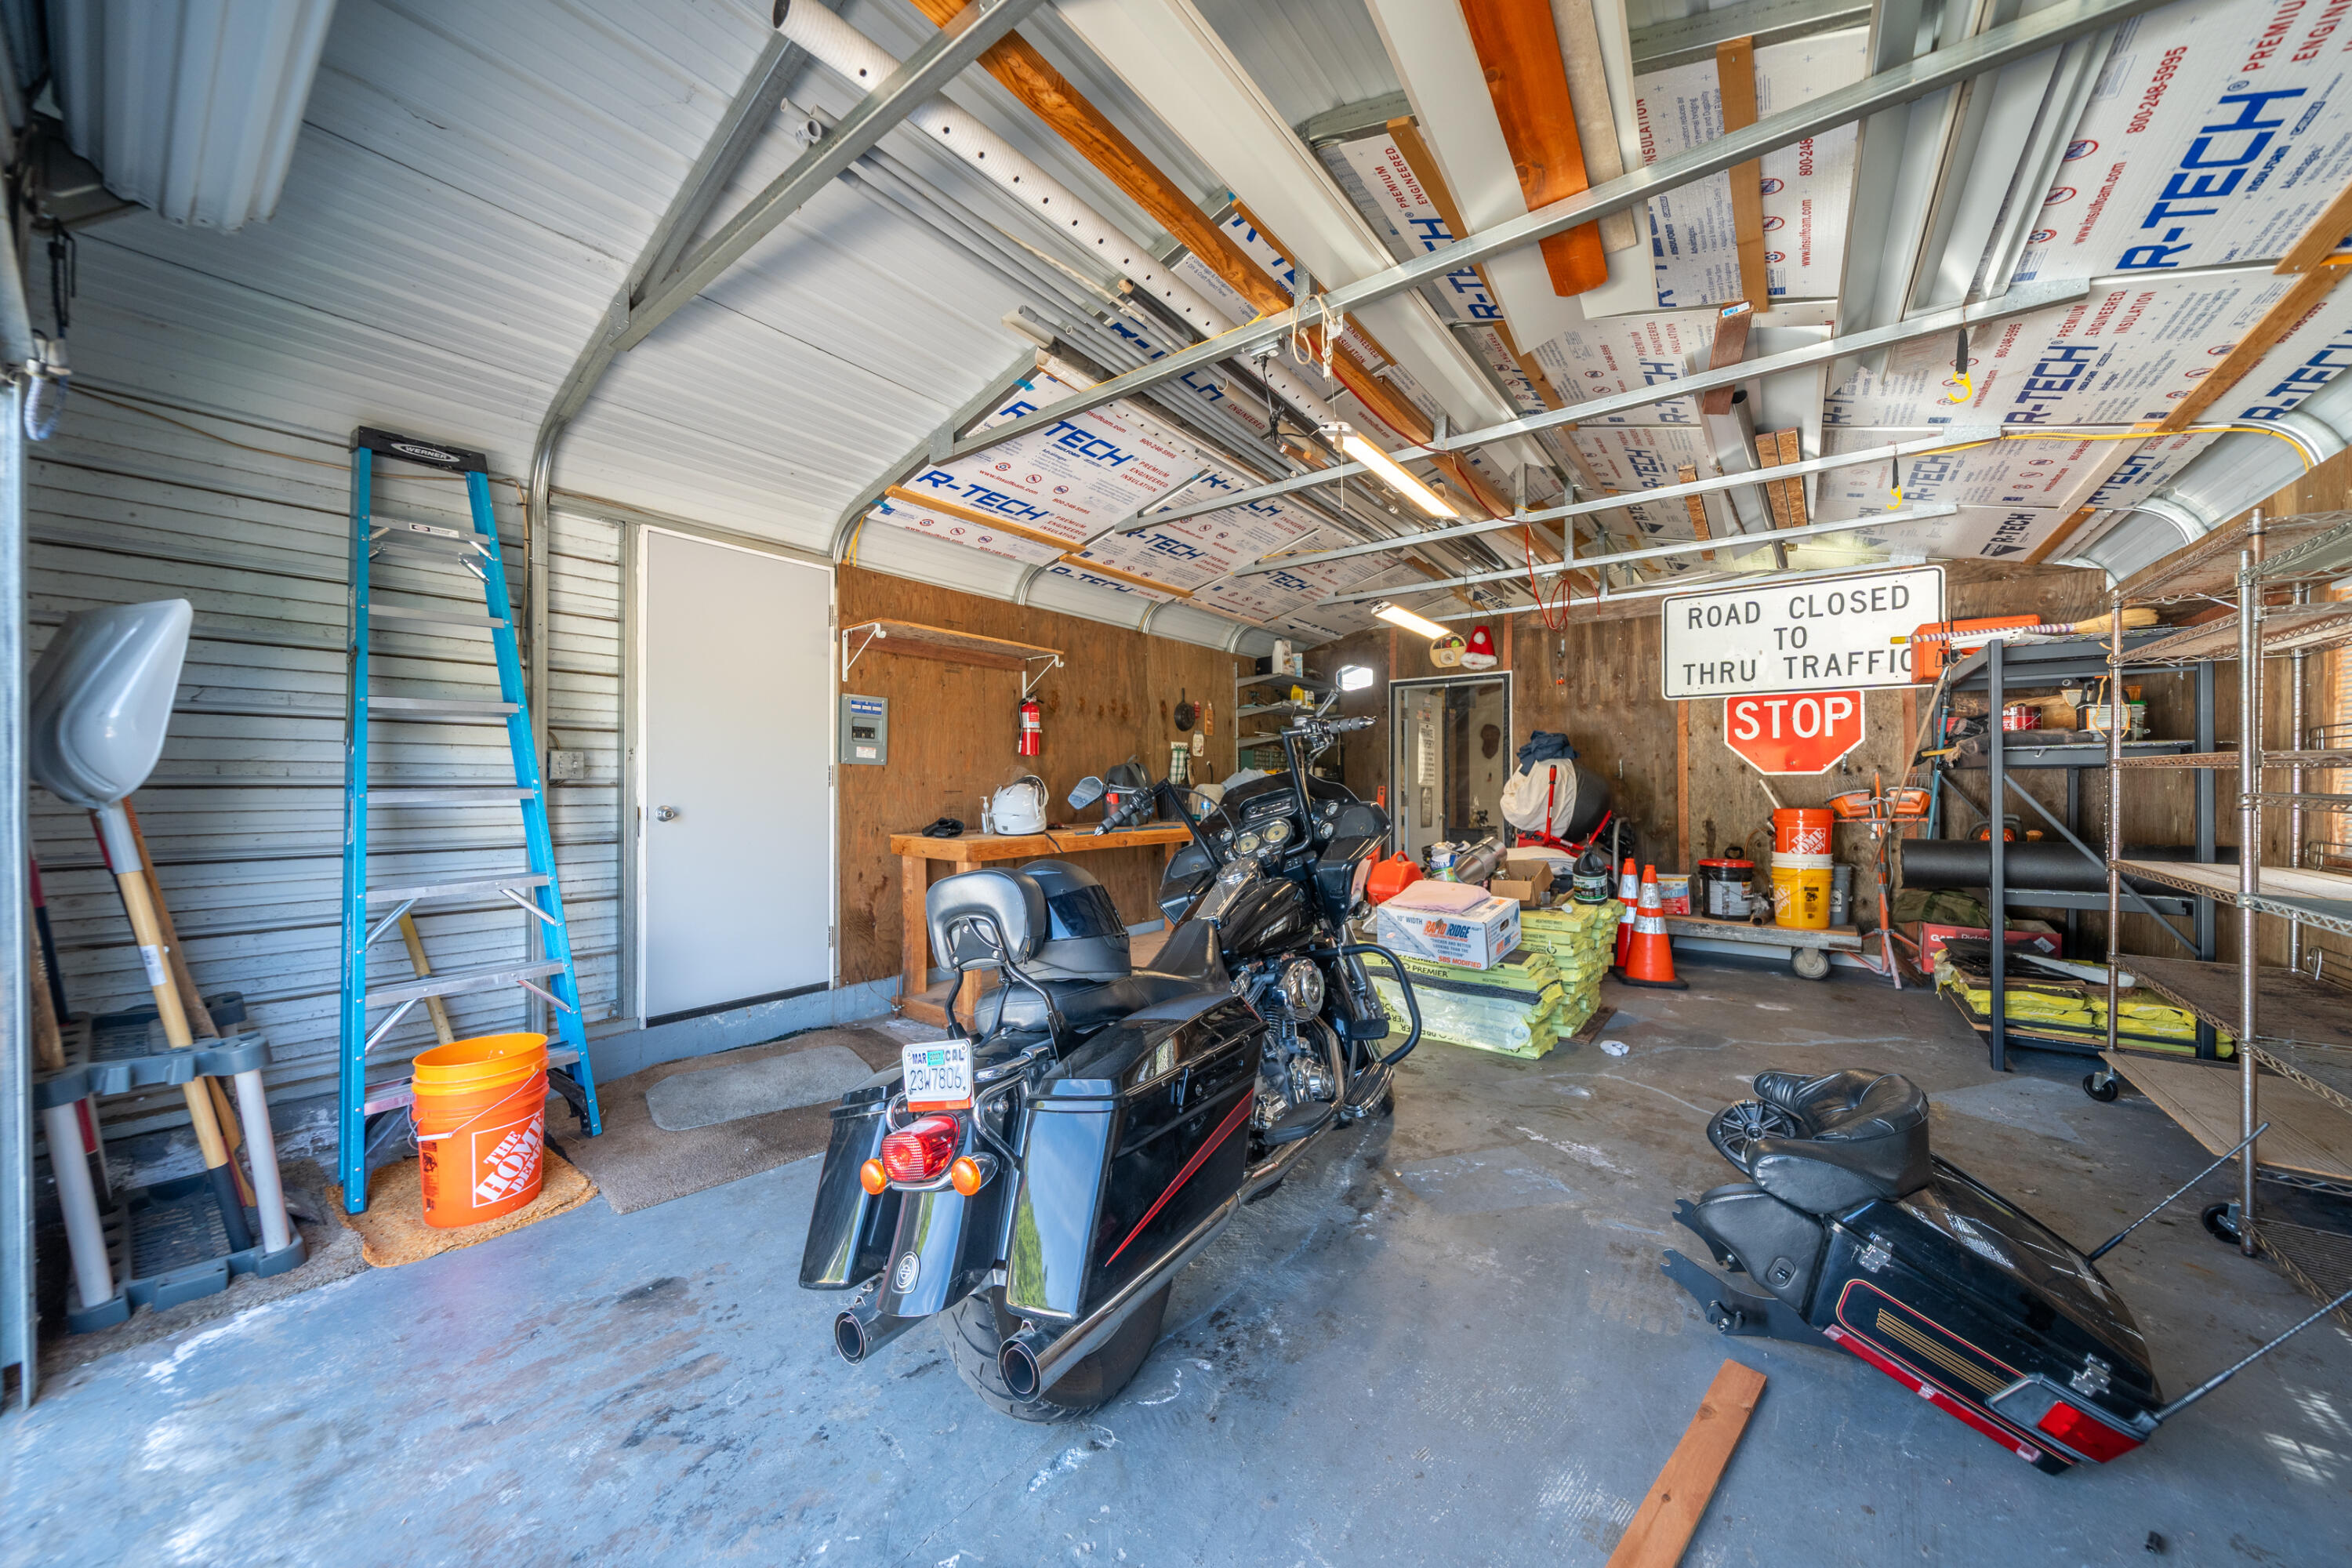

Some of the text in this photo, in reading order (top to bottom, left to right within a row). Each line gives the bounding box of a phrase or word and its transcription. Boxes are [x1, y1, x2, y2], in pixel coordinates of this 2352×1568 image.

[2241, 0, 2307, 72] PREMIU
[2290, 0, 2352, 62] ENGIN
[2126, 46, 2187, 133] 800-248-5995
[1799, 138, 1813, 176] 800-248
[1375, 165, 1410, 209] PREMIUM
[1385, 147, 1428, 205] ENGINEERED
[2073, 162, 2127, 245] www.insulfoam.com
[1800, 199, 1813, 267] www.insulfoam.com
[2057, 304, 2089, 338] PREMIUM
[2085, 291, 2127, 336] ENGINEERED
[2113, 291, 2158, 334] INSULATION
[1336, 336, 1367, 365] NSULATION
[1631, 332, 1646, 356] PREMIUM
[1646, 322, 1664, 356] ENGINEERED
[1666, 323, 1682, 354] INSULATION
[1085, 410, 1127, 433] nsulfoam.com
[1228, 402, 1265, 430] ENGINEERED
[405, 445, 448, 460] WERNER
[979, 470, 1038, 495] www.insulfoam.com
[1120, 473, 1157, 492] INSULATION
[1130, 467, 1169, 488] ENGINEERED
[1138, 461, 1170, 478] PREMIUM
[1040, 525, 1076, 540] INSULATION
[1047, 521, 1087, 536] ENGINEERED
[1055, 515, 1087, 528] PREMIUM
[1995, 512, 2036, 544] R-TECH
[1688, 585, 1910, 630] ROAD CLOSED
[1773, 626, 1808, 651] TO
[1682, 659, 1756, 685] THRU
[1733, 696, 1853, 741] STOP
[1788, 828, 1825, 854] HOME
[1791, 831, 1808, 844] THE
[1406, 916, 1423, 925] WIDTH
[1446, 923, 1471, 938] RIDGE
[1412, 965, 1448, 978] PREMIER
[1452, 958, 1482, 968] MODIFIED
[913, 1053, 927, 1065] MAR
[945, 1051, 964, 1062] CAL
[910, 1067, 963, 1091] 23W7806
[483, 1131, 521, 1166] THE
